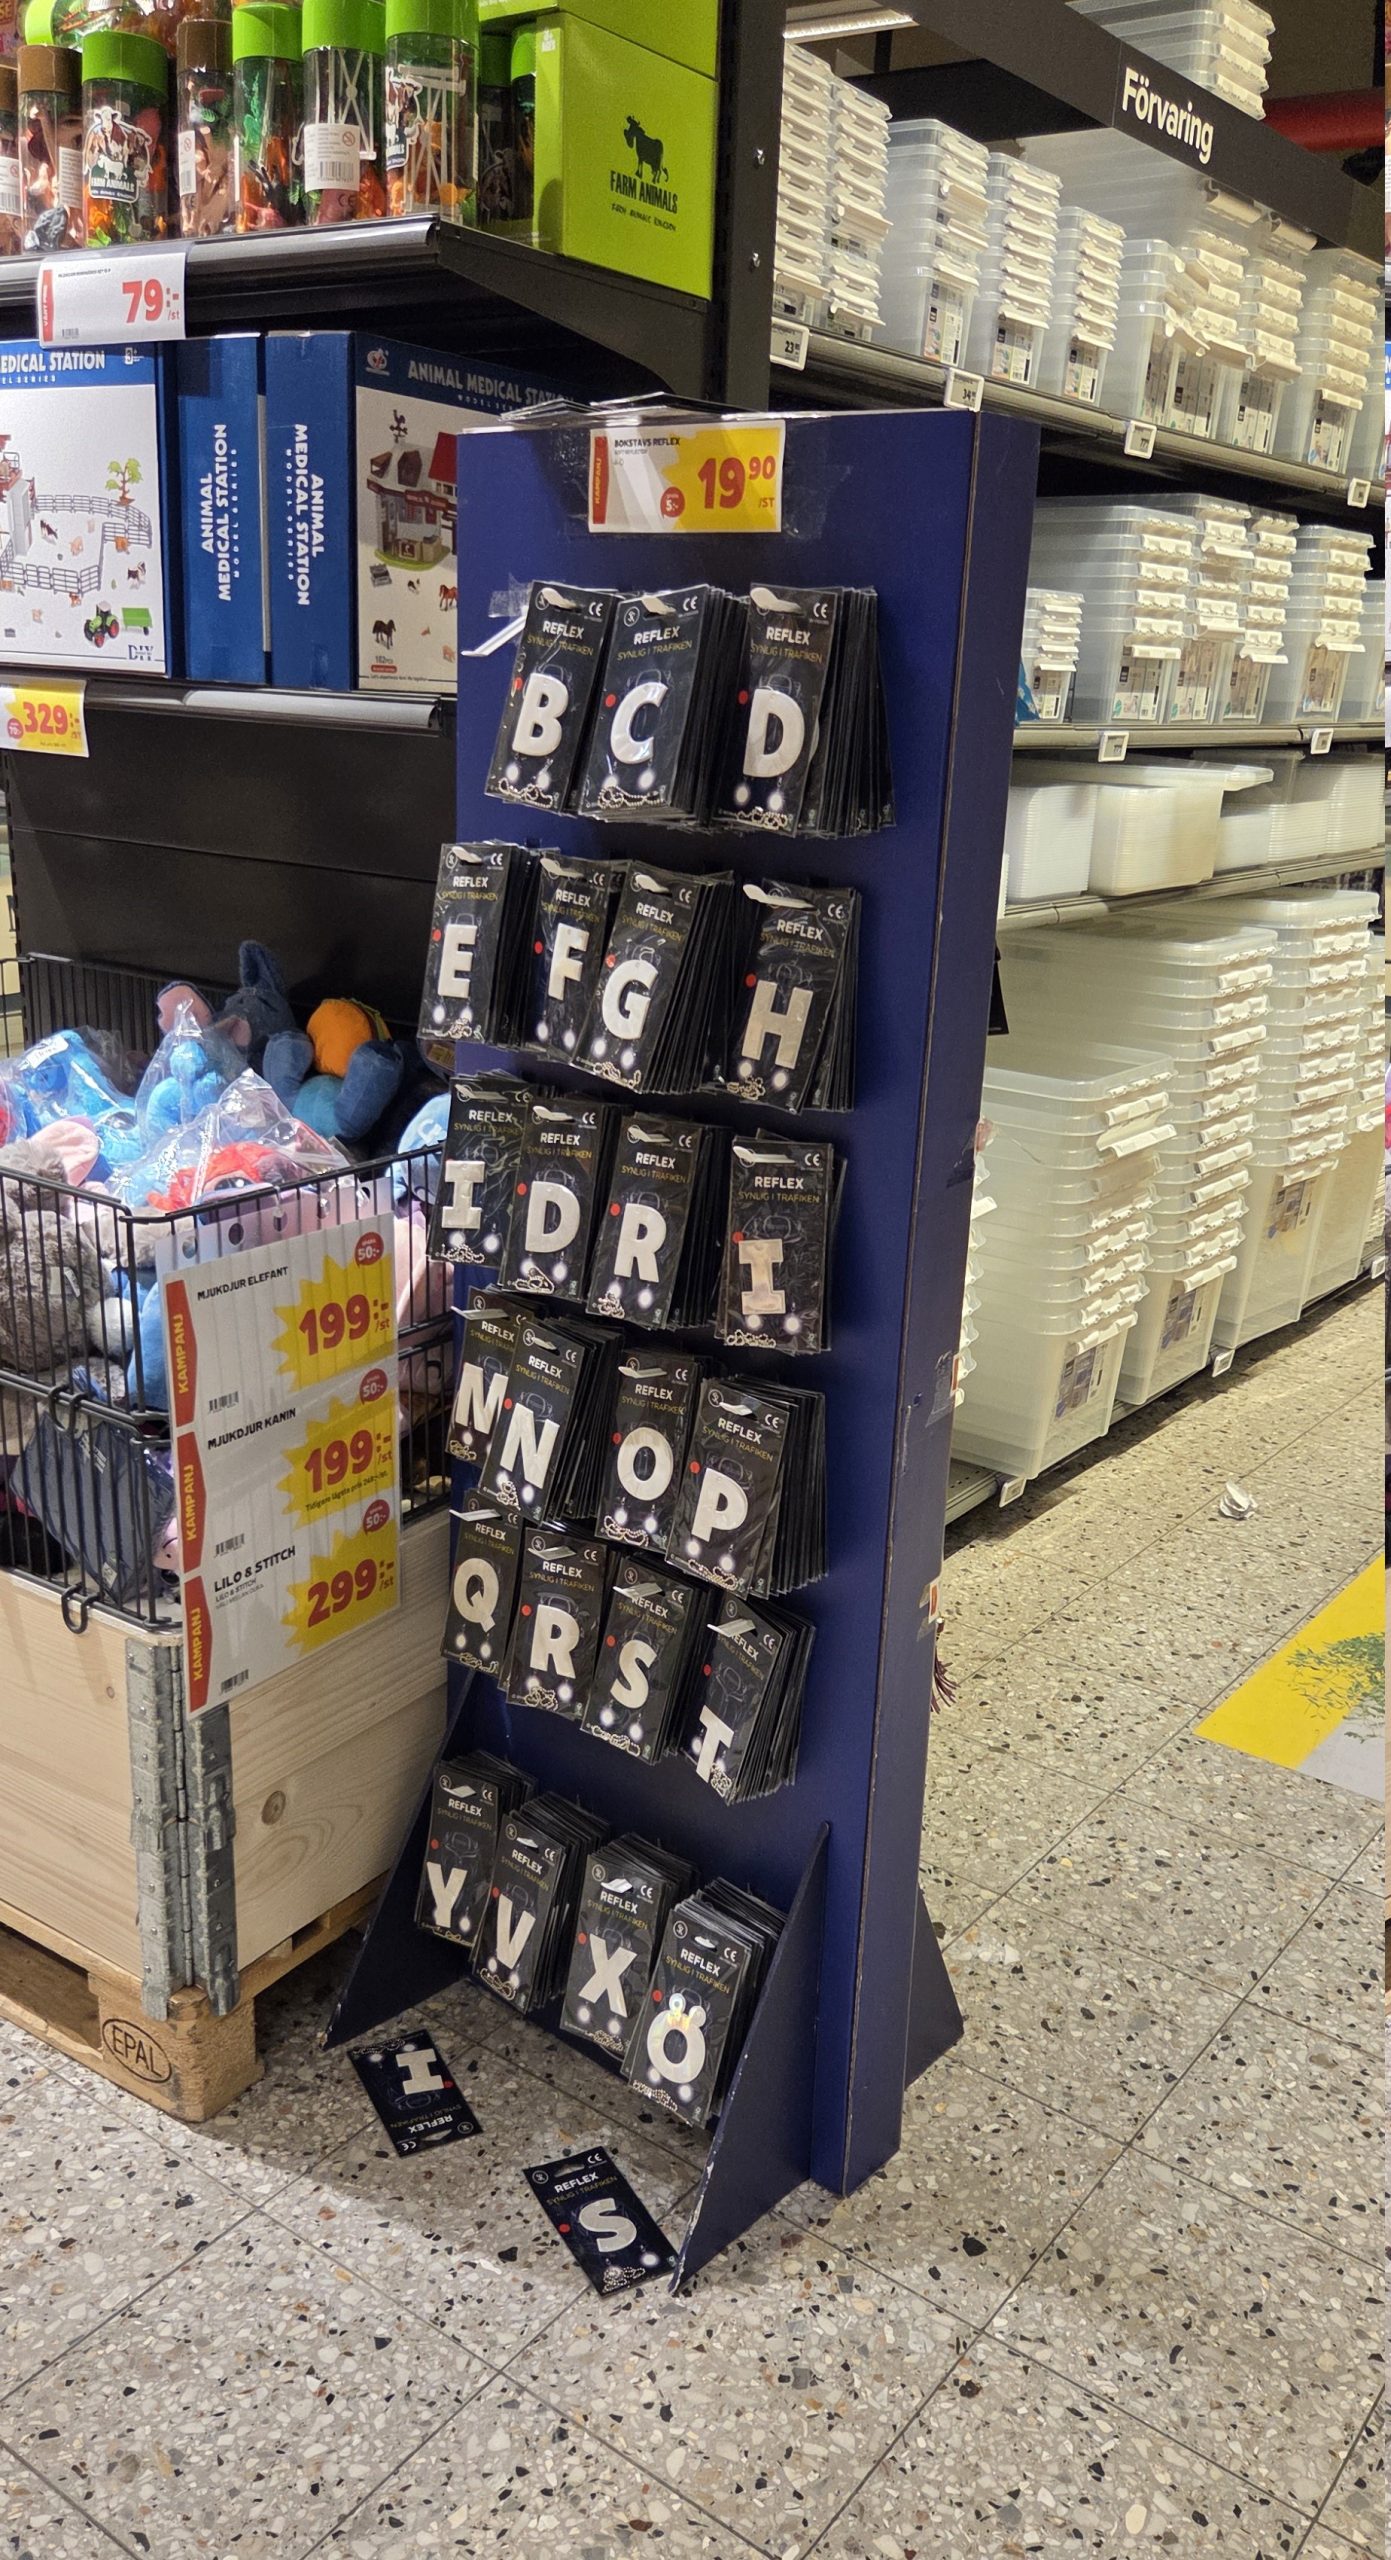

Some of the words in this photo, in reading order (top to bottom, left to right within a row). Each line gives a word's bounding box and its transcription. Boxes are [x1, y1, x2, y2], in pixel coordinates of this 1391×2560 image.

[1122, 66, 1214, 164] Förvaring
[610, 170, 637, 200] FARM
[639, 181, 678, 214] ANIMALS
[49, 350, 105, 372] STATION
[784, 341, 794, 353] 23
[408, 360, 463, 390] ANIMAL
[467, 373, 522, 403] MEDICAL
[614, 437, 652, 448] BOKSTAVS
[653, 436, 681, 447] REFLEX
[215, 424, 229, 508] STATION
[295, 424, 309, 516] MEDICAL
[200, 472, 214, 554] ANIMAL
[311, 474, 325, 558] ANIMAL
[758, 497, 775, 508] /ST
[217, 513, 232, 601] MEDICAL
[297, 521, 310, 605] STATION
[542, 620, 584, 639] REFLEX
[617, 648, 646, 661] SYNLIG
[652, 640, 692, 654] TRAFIKEN
[633, 626, 680, 645] REFLEX
[766, 626, 811, 646] REFLEX
[128, 644, 154, 661] DIY
[512, 672, 569, 757] B
[611, 682, 669, 764] C
[743, 688, 805, 778] D
[453, 876, 489, 888] REFLEX
[555, 888, 590, 907] REFLEX
[635, 902, 674, 925] REFLEX
[776, 919, 824, 941] REFLEX
[437, 923, 478, 999] E
[548, 922, 590, 1001] F
[601, 959, 659, 1040] G
[742, 979, 814, 1070] H
[468, 1109, 513, 1123] REFLEX
[540, 1132, 581, 1146] REFLEX
[635, 1151, 676, 1169] REFLEX
[441, 1160, 485, 1229] I
[621, 1165, 645, 1178] SYNLIG
[651, 1170, 686, 1183] TRAFIKEN
[754, 1176, 804, 1190] REFLEX
[525, 1180, 581, 1253] D
[738, 1191, 769, 1201] SYNLIG
[777, 1193, 819, 1203] TRAFIKEN
[613, 1203, 667, 1283] R
[197, 1279, 246, 1301] MJUKDJUR
[248, 1266, 288, 1286] ELEFANT
[738, 1238, 786, 1315] I
[374, 1317, 389, 1333] /st
[482, 1321, 515, 1342] REFLEX
[174, 1313, 189, 1394] KAMPANJ
[529, 1355, 562, 1379] REFLEX
[635, 1384, 673, 1400] REFLEX
[207, 1423, 263, 1450] MJUKDJUR
[264, 1407, 296, 1429] KANIN
[500, 1403, 560, 1489] N
[718, 1418, 762, 1444] REFLEX
[617, 1427, 673, 1500] O
[184, 1464, 197, 1541] KAMPANJ
[691, 1467, 748, 1542] P
[476, 1523, 506, 1541] REFLEX
[214, 1571, 242, 1593] LILO
[244, 1566, 253, 1578] &
[254, 1545, 296, 1574] STITCH
[236, 1577, 257, 1593] STITCH
[379, 1578, 394, 1592] /st
[543, 1561, 582, 1579] REFLEX
[454, 1558, 499, 1632] Q
[192, 1608, 204, 1680] KAMPANJ
[530, 1604, 580, 1679] R
[731, 1633, 759, 1662] EFLEX
[610, 1640, 657, 1709] S
[696, 1705, 734, 1783] T
[448, 1799, 482, 1816] REFLEX
[512, 1849, 543, 1875] REFLEX
[426, 1862, 468, 1928] Y
[600, 1891, 638, 1914] REFLEX
[497, 1893, 536, 1969] V
[578, 1933, 637, 2018] X
[665, 1956, 691, 1975] SYNLIG
[696, 1971, 730, 1994] TRAFIKEN
[681, 1948, 720, 1976] REFLEX
[112, 2024, 162, 2078] EPAL
[647, 1993, 706, 2083] Ö
[396, 2048, 444, 2095] I
[408, 2115, 453, 2133] REFLEX
[554, 2172, 600, 2193] REFLEX
[579, 2198, 637, 2252] S
